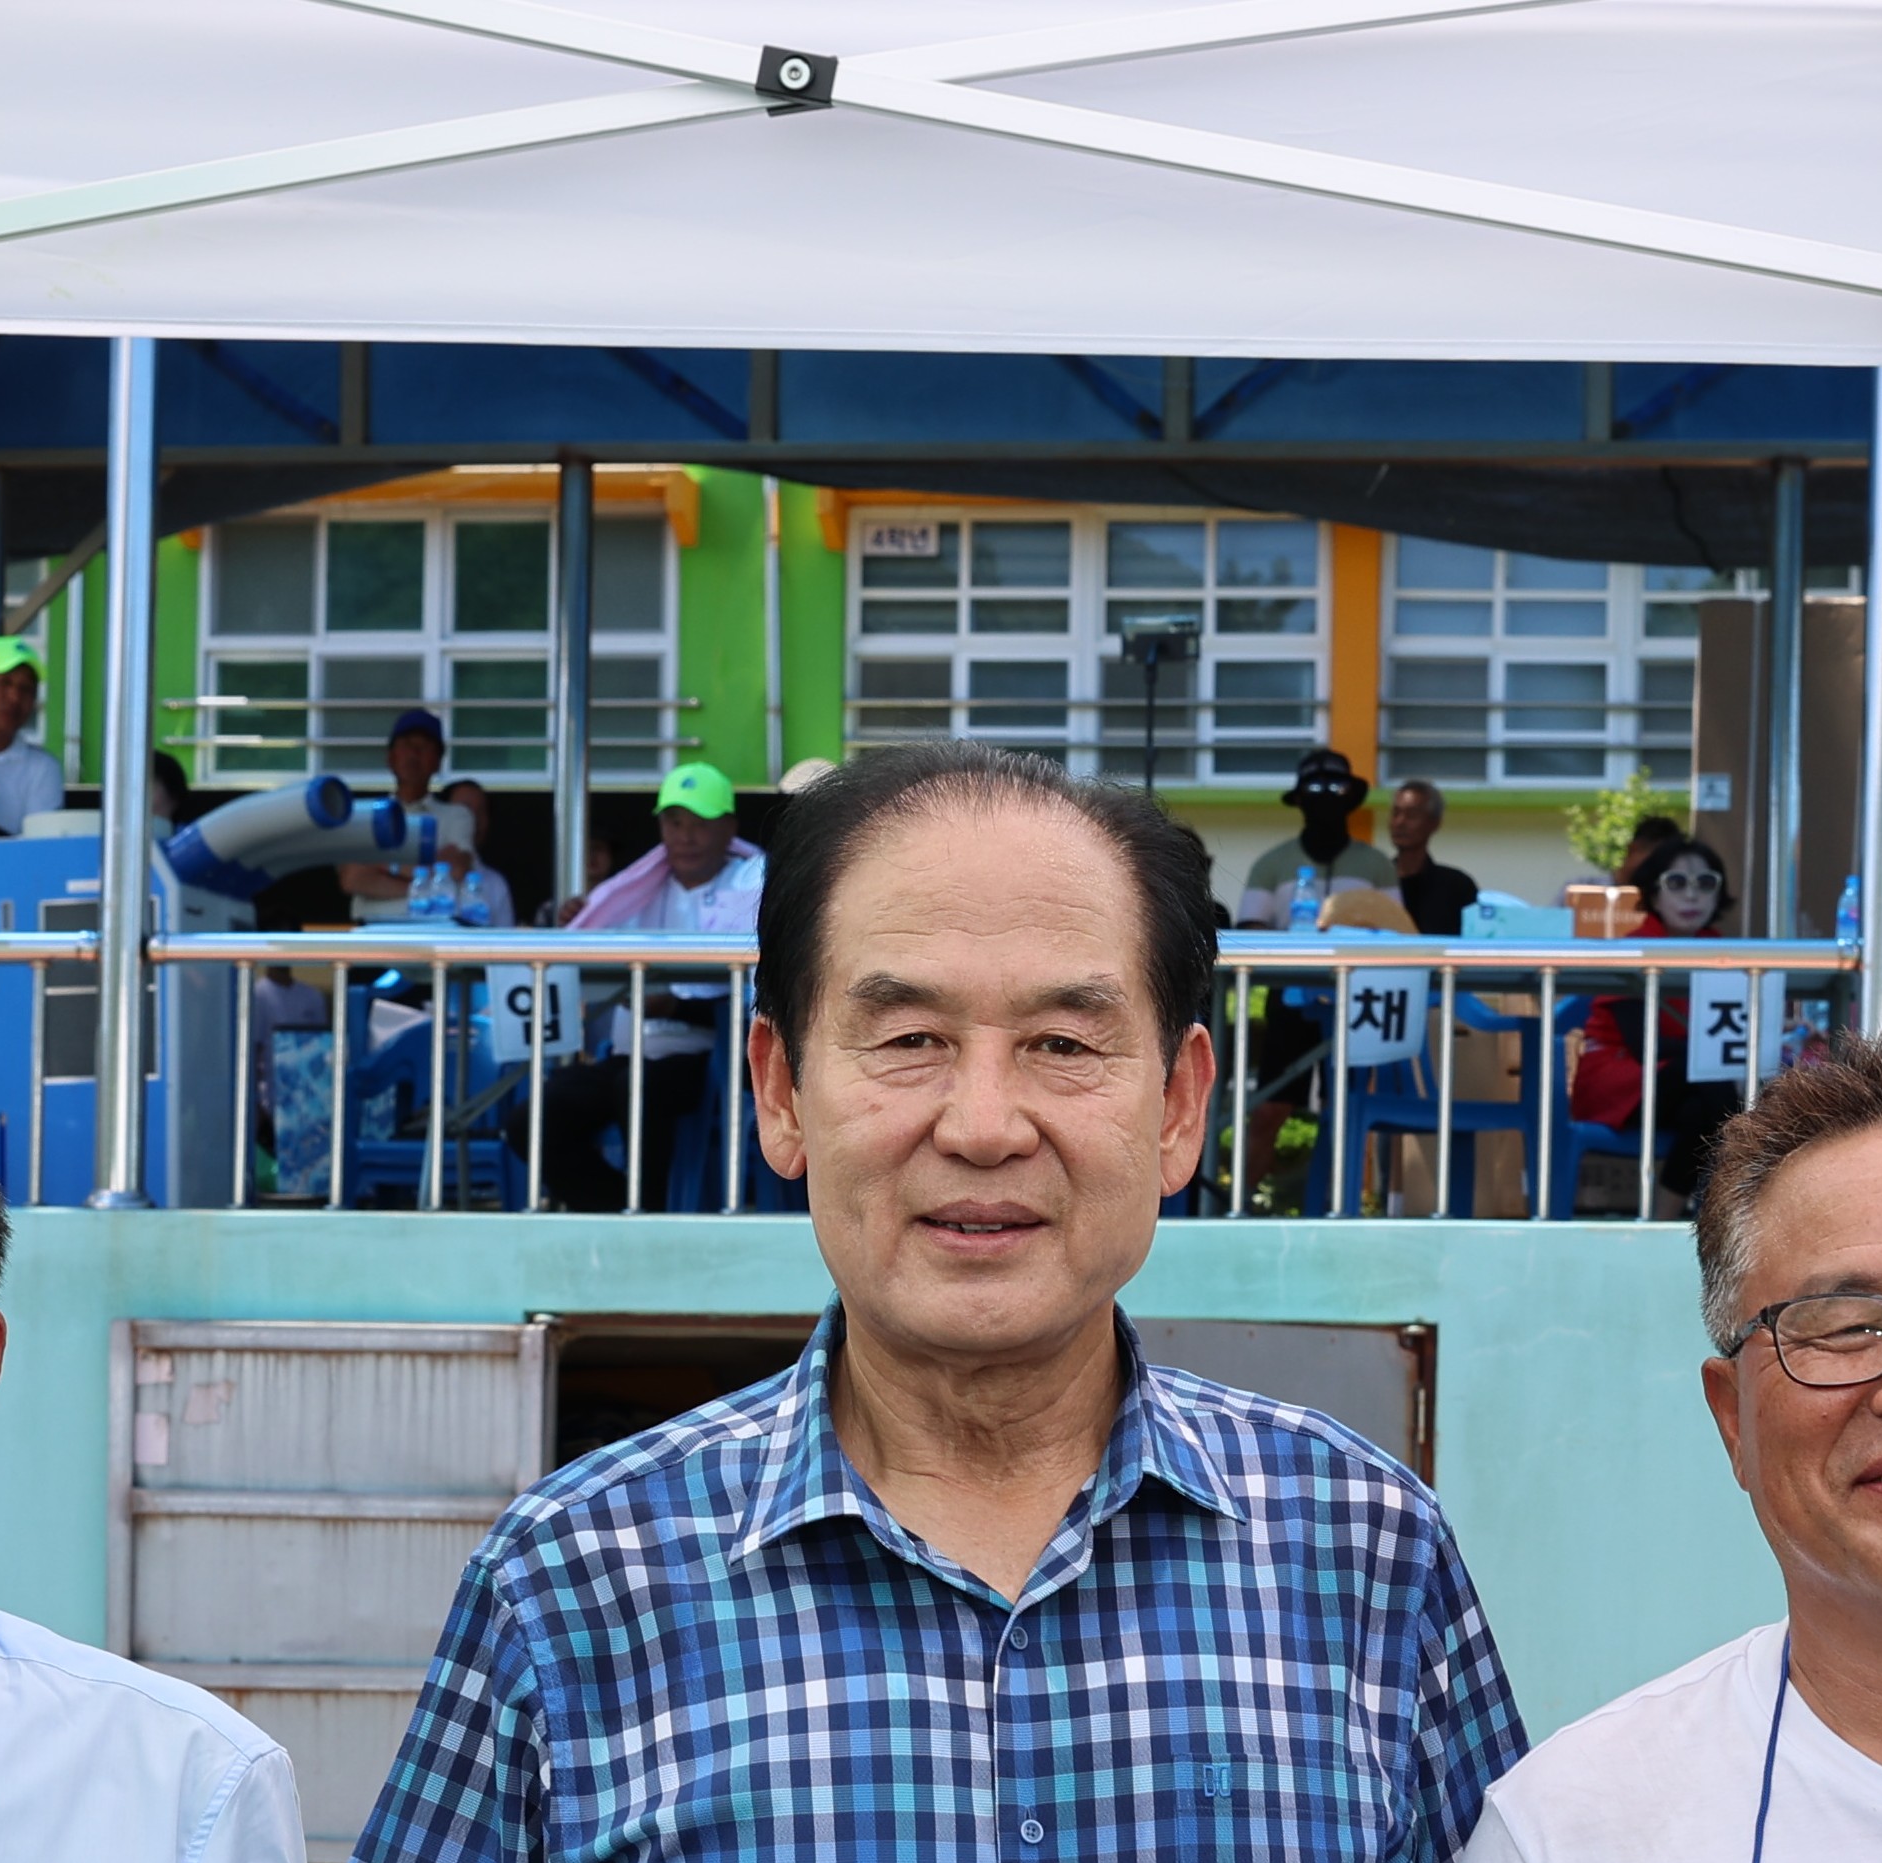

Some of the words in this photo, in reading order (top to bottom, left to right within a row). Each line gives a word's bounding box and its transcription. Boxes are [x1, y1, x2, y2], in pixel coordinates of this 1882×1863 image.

[871, 527, 929, 552] 4학년
[1349, 987, 1408, 1043] 채
[1707, 1001, 1751, 1066] 점
